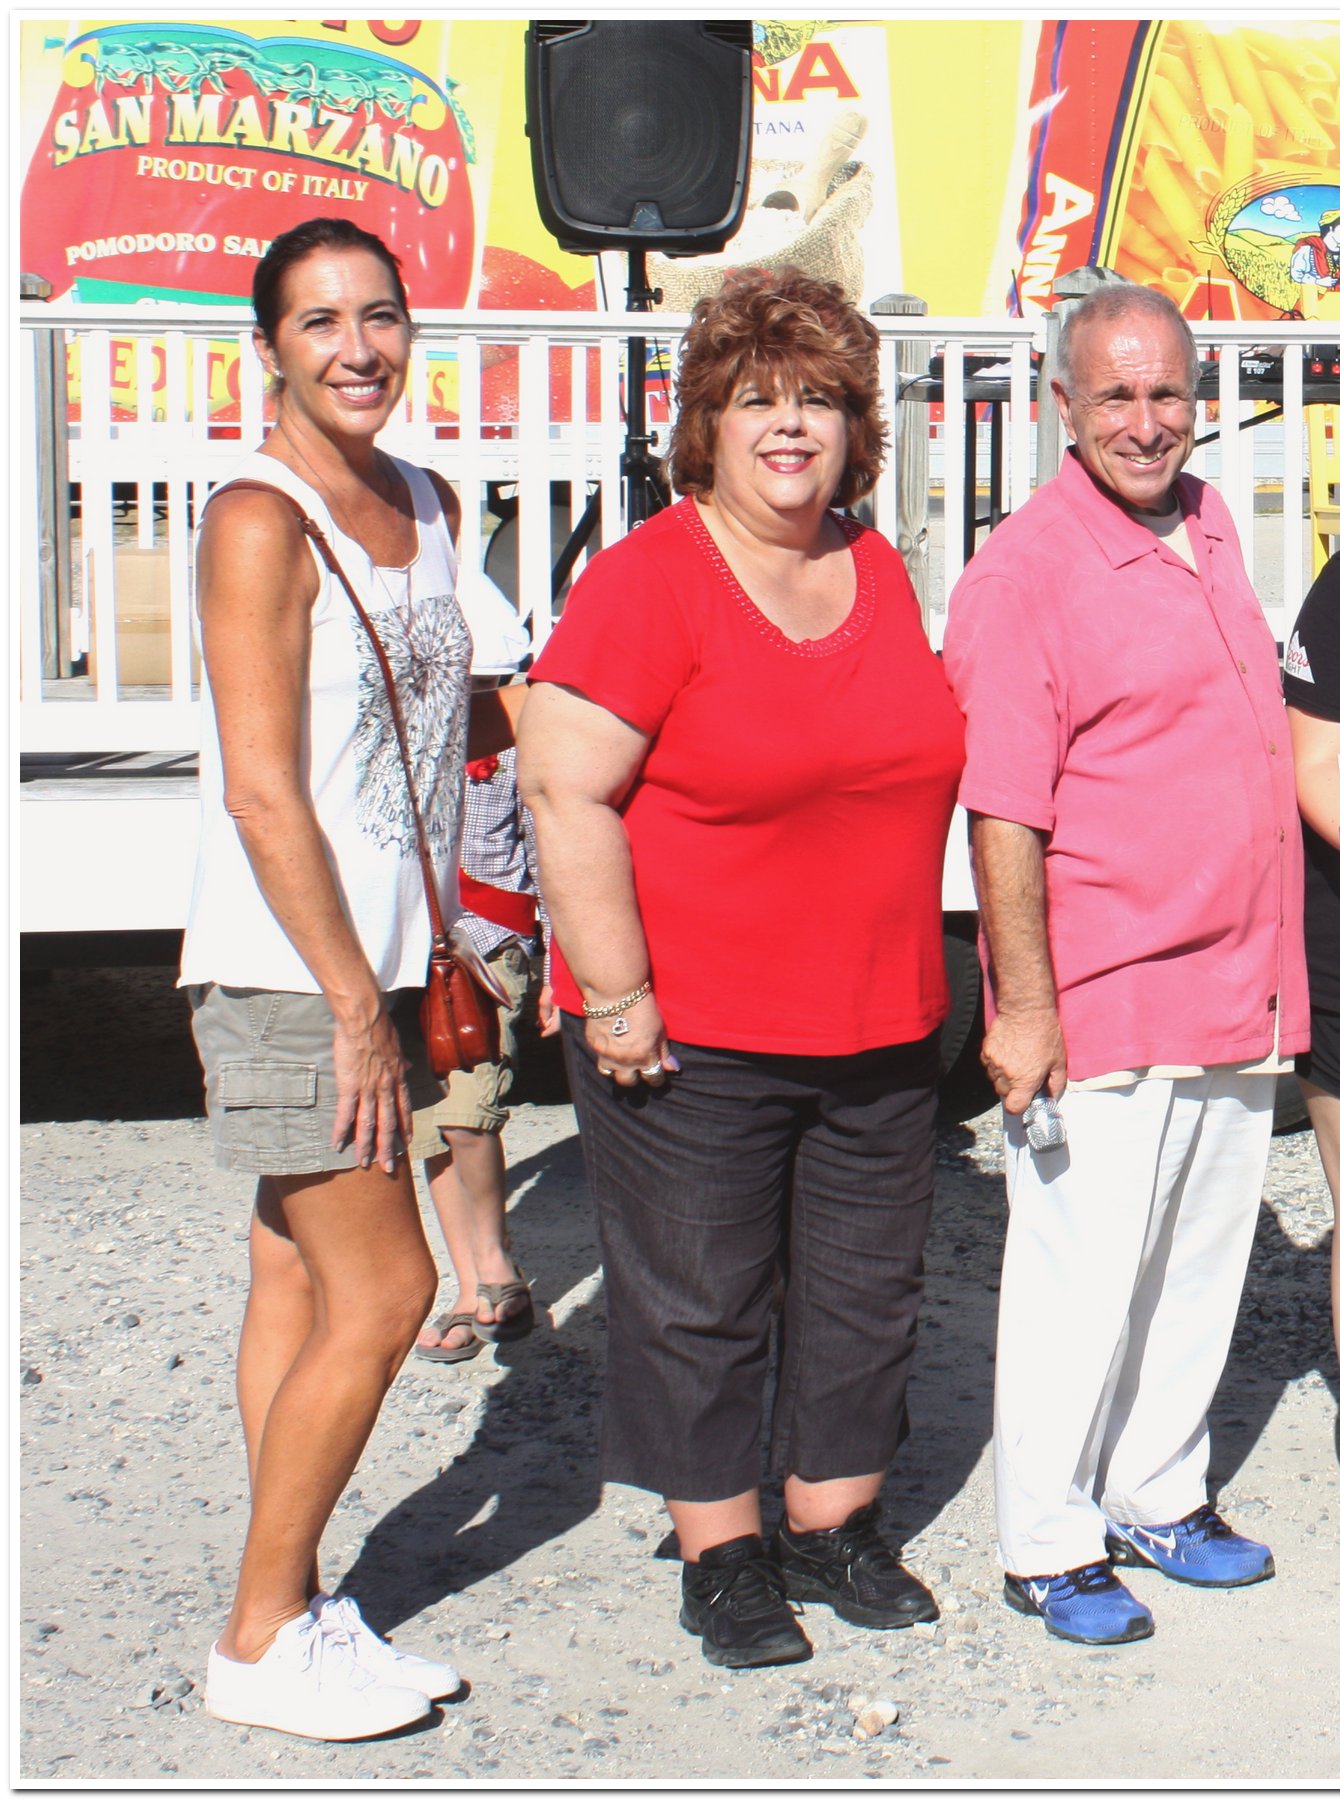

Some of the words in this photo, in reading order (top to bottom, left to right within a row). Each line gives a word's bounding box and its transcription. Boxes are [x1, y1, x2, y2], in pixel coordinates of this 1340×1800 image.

[753, 43, 860, 102] NA
[54, 95, 154, 166] SAN
[165, 94, 448, 209] MARZANO
[753, 120, 805, 135] TANA
[136, 154, 257, 190] PRODUCT
[262, 169, 297, 193] OF
[302, 174, 369, 201] ITALY
[65, 232, 216, 266] POMODORO
[1020, 172, 1095, 318] ANN
